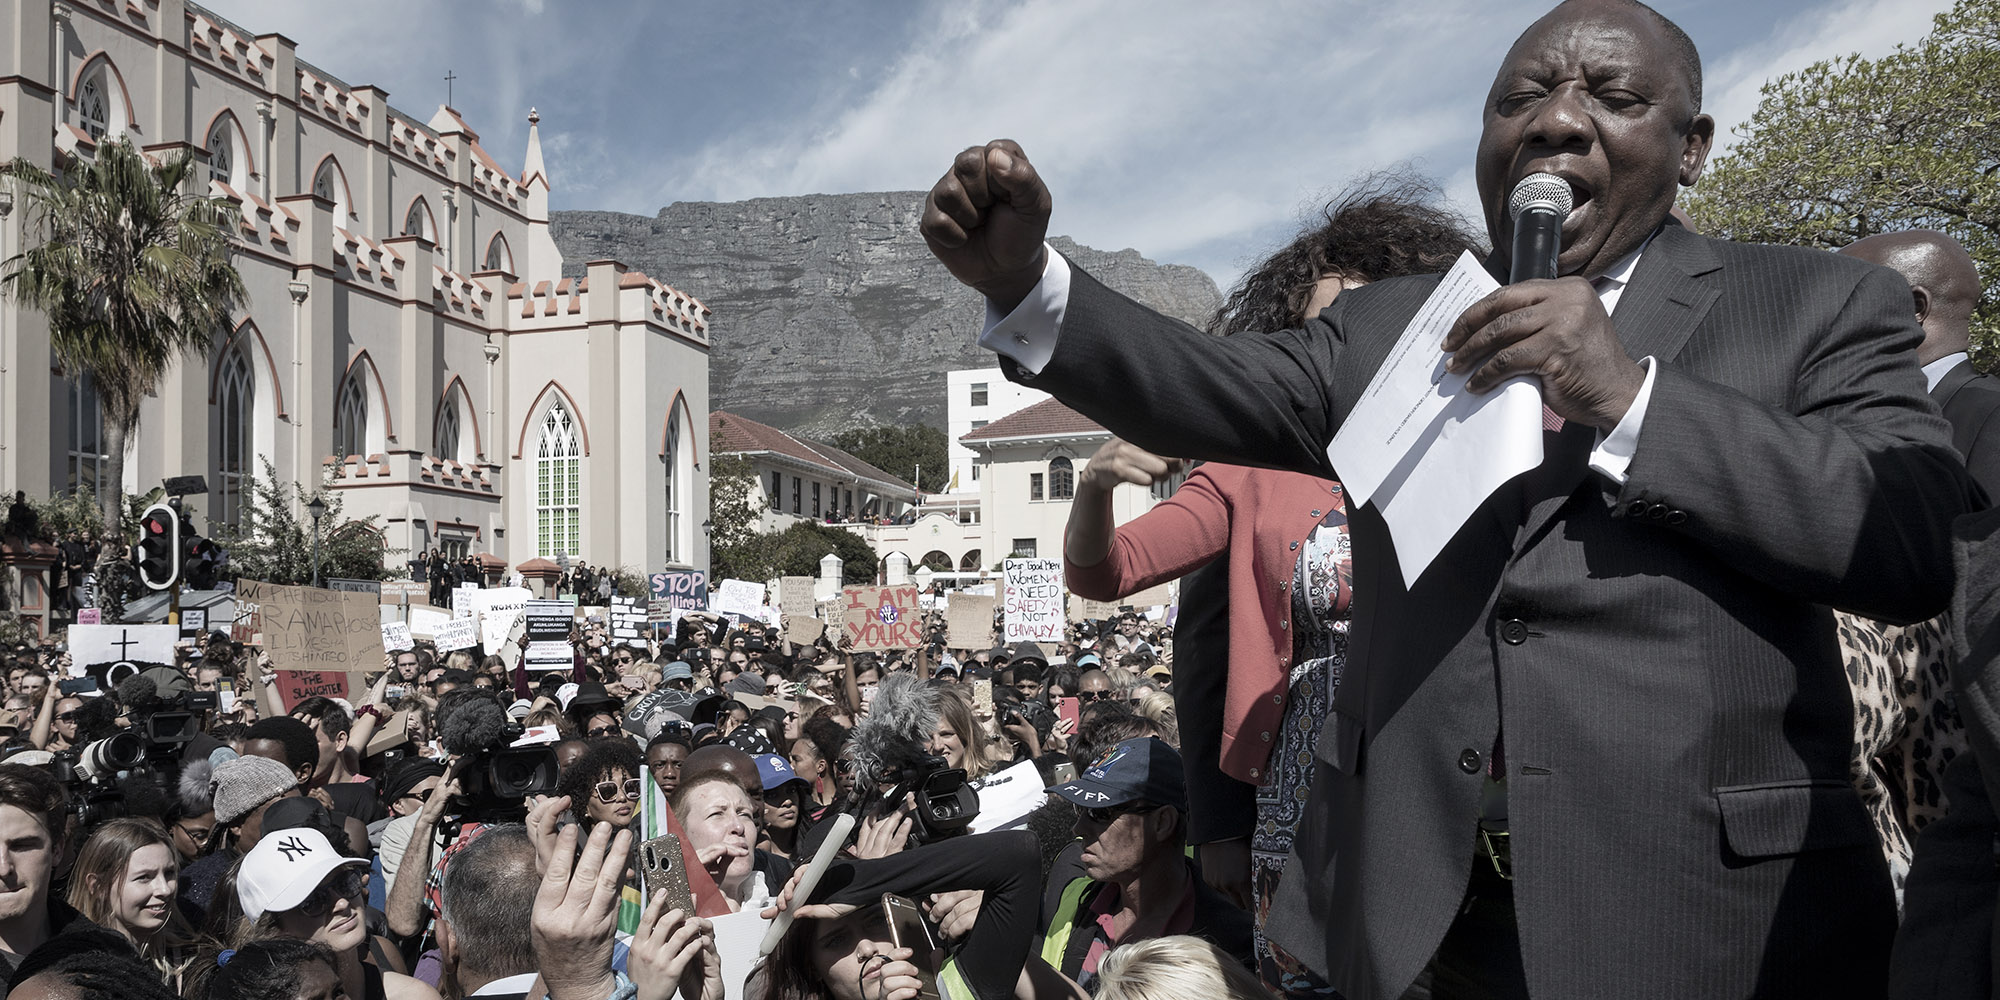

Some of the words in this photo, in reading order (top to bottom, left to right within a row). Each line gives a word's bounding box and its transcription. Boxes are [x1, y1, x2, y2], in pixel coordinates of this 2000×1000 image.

[652, 572, 704, 596] STOP
[1008, 570, 1049, 585] WOMEN
[843, 589, 867, 609] I
[878, 588, 917, 608] AM
[1020, 585, 1059, 598] NEED
[234, 599, 259, 612] JUST
[1006, 597, 1049, 613] SAFETY
[263, 604, 379, 634] RAMAPHOSA
[866, 608, 908, 623] NT
[884, 612, 895, 621] NO
[1022, 613, 1048, 622] NOT
[848, 620, 921, 648] YOURS
[1008, 623, 1055, 638] CHIVALRY
[453, 637, 475, 648] MAN
[302, 673, 323, 685] THE
[292, 683, 343, 699] SLAUGHTER
[628, 691, 661, 721] GROW
[1064, 785, 1110, 803] FIFA
[278, 836, 312, 862] NY
